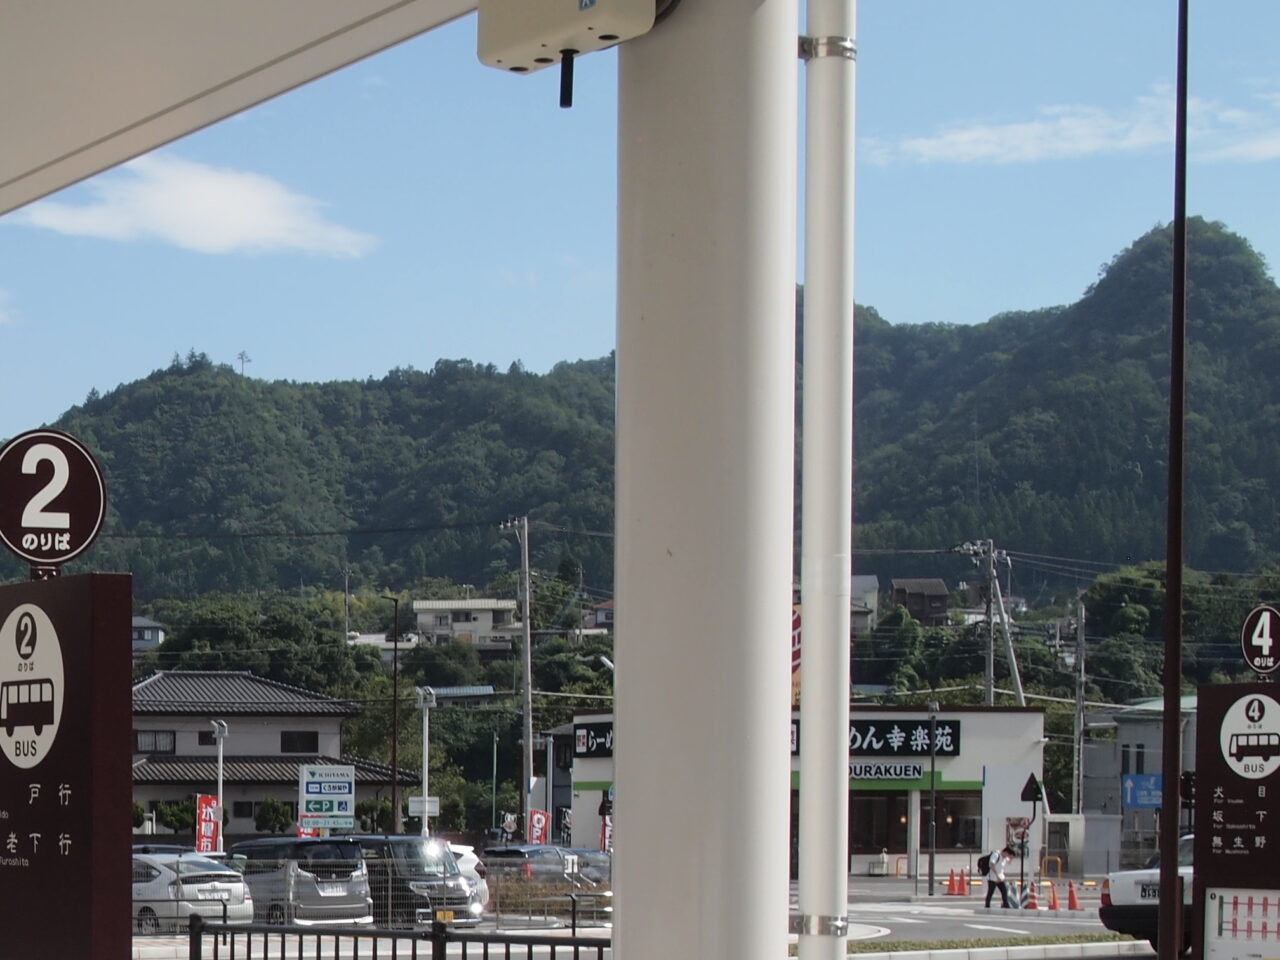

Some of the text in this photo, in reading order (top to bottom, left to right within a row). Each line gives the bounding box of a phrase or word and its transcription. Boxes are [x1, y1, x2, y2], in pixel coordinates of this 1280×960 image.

[21, 443, 70, 529] 2
[21, 532, 71, 551] のりば
[20, 615, 33, 655] 2
[1252, 611, 1273, 656] 4
[1248, 700, 1261, 721] 4
[14, 740, 38, 757] BUS
[1244, 763, 1265, 773] BUS
[322, 801, 330, 812] P
